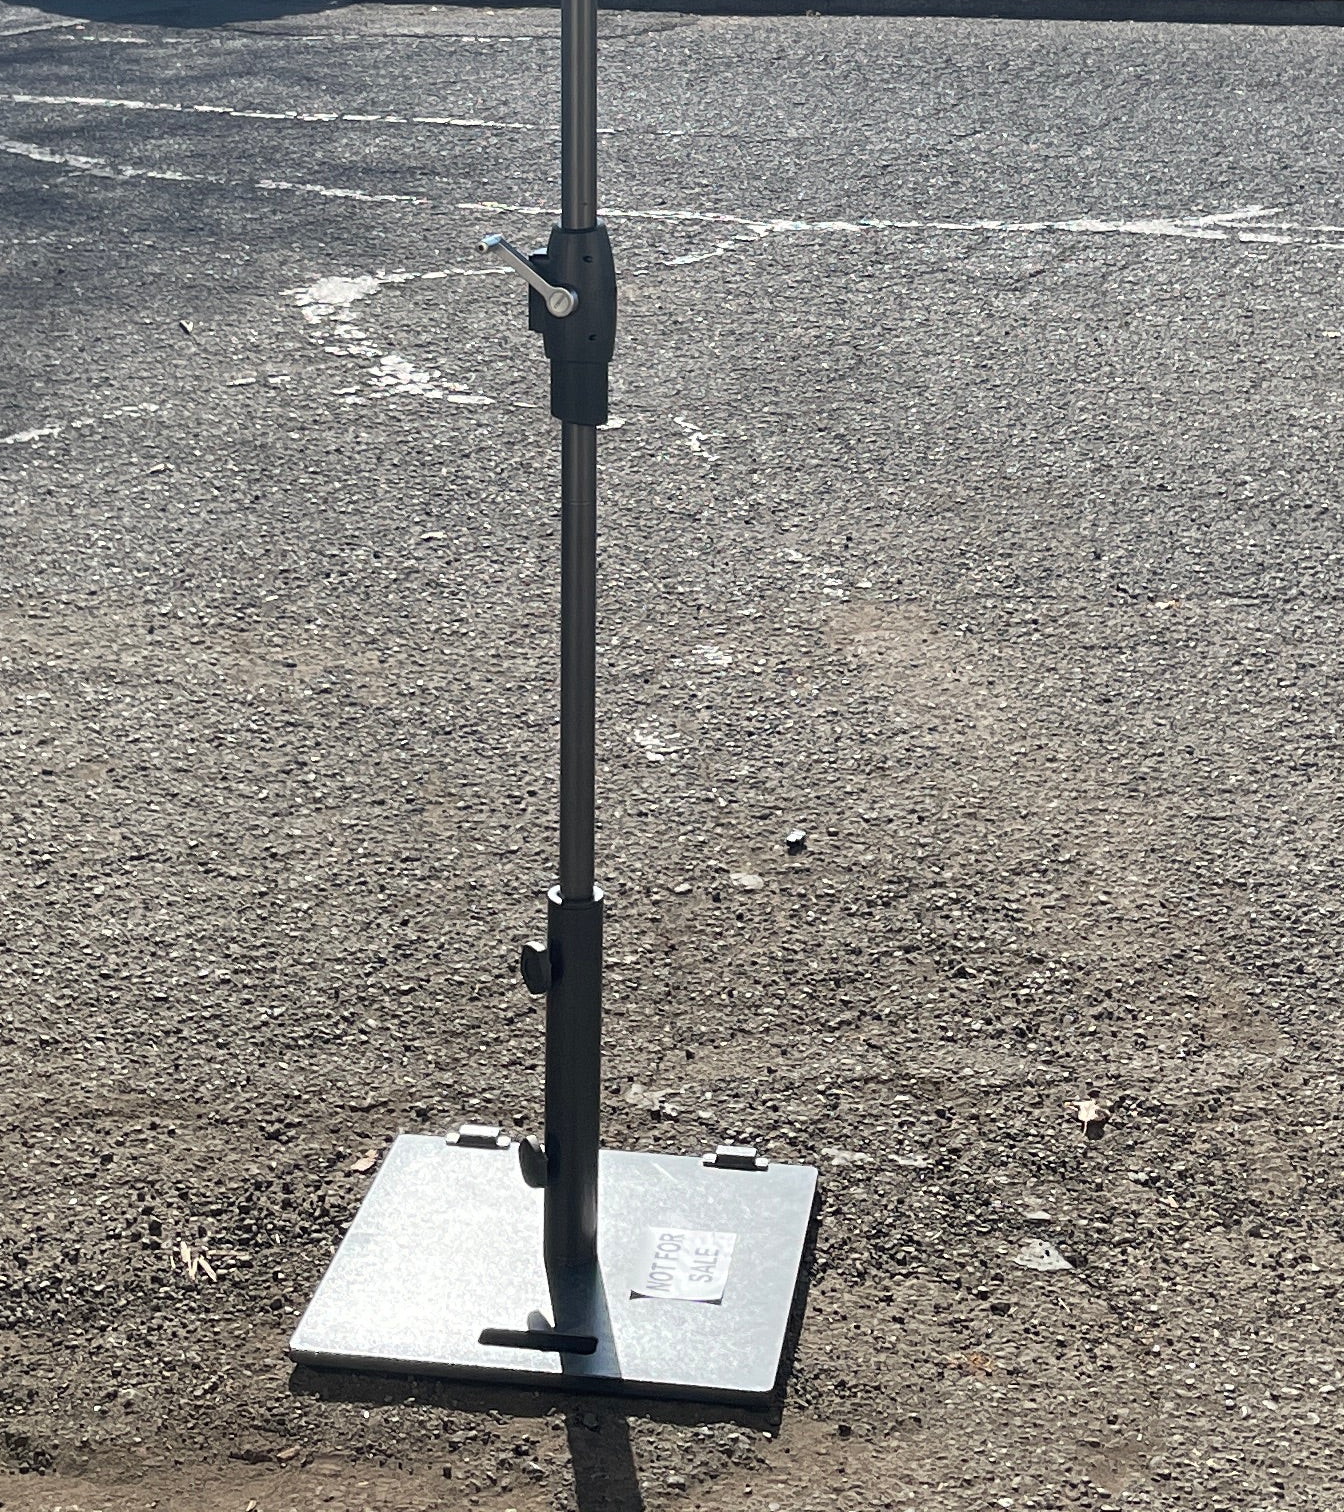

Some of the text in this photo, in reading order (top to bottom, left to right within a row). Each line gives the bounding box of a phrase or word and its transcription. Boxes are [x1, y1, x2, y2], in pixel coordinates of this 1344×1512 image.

[646, 1233, 685, 1292] NOT FOR
[688, 1247, 720, 1283] SALE
